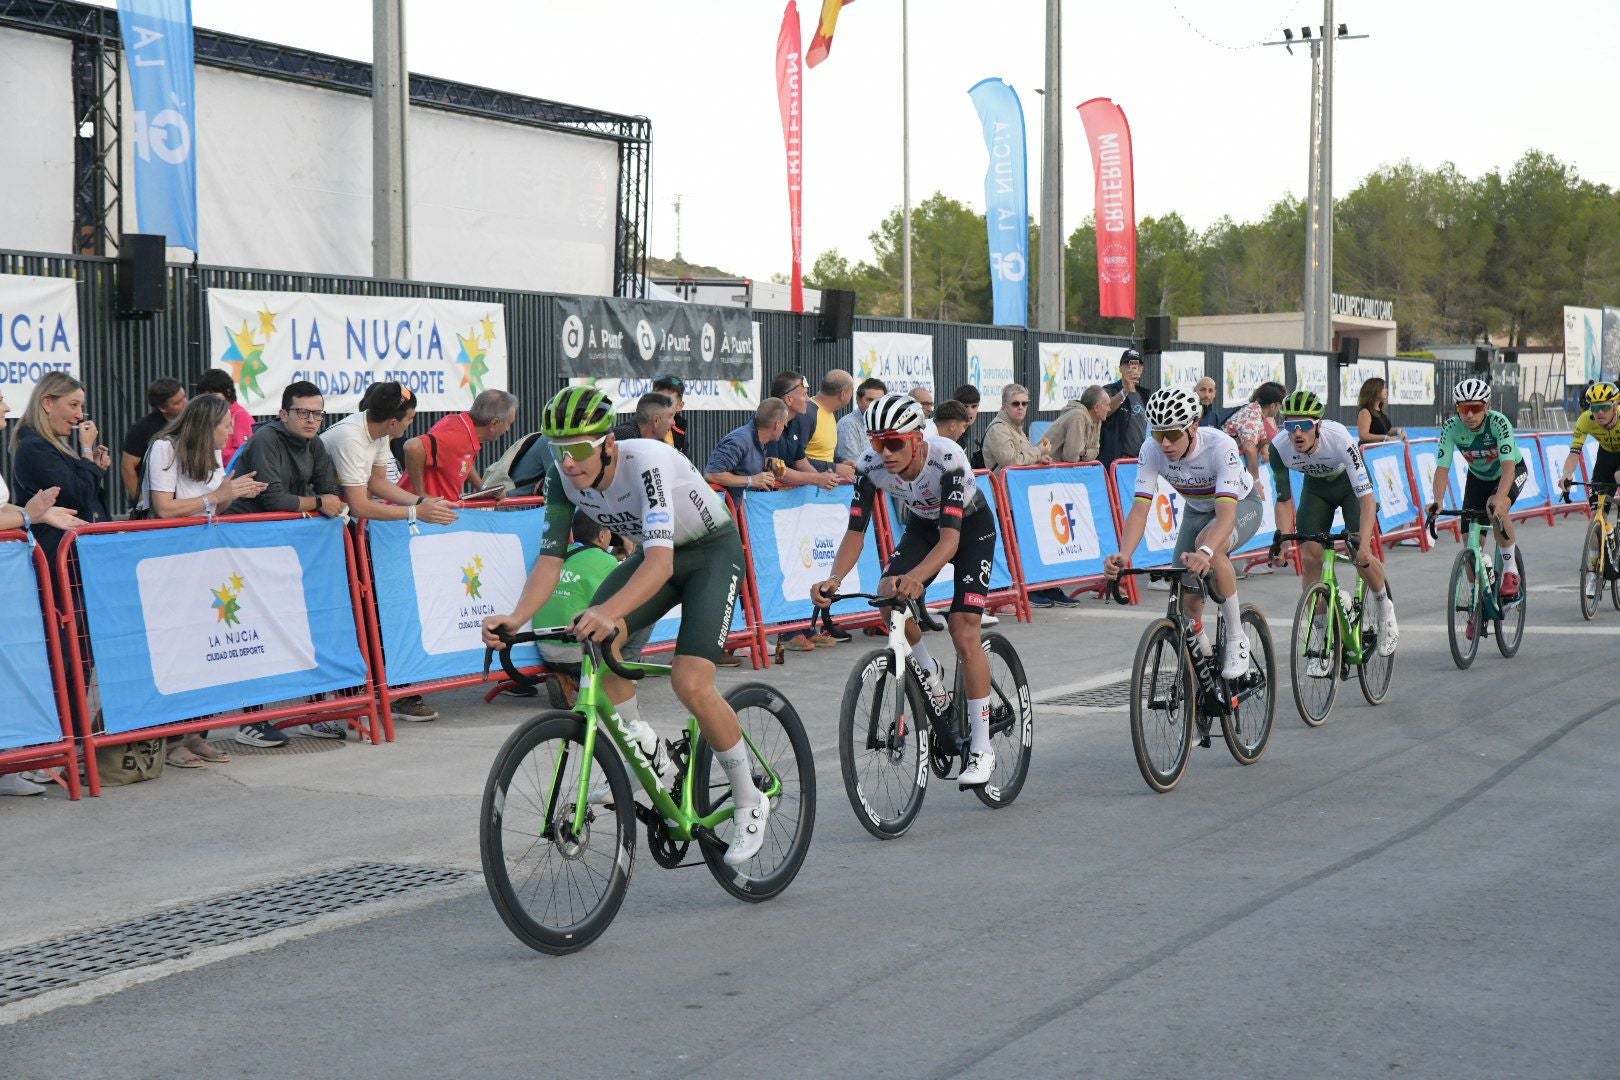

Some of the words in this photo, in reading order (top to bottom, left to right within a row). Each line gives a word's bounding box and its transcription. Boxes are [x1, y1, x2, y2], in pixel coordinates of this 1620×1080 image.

[291, 317, 325, 360] LA
[601, 329, 624, 350] Punt
[667, 333, 691, 352] Punt
[731, 336, 752, 354] Punt
[1063, 358, 1073, 380] LA
[684, 379, 719, 395] EPORTE
[1493, 415, 1510, 439] KERN
[641, 469, 658, 509] RGA
[652, 467, 667, 508] SEGUROS
[689, 489, 704, 511] CAJA
[598, 511, 639, 524] CAJA
[1051, 503, 1076, 545] GF
[206, 651, 227, 662] CIUDAD
[229, 649, 239, 659] DEL
[239, 645, 264, 657] DEPORTE
[911, 656, 942, 717] COLNAGO
